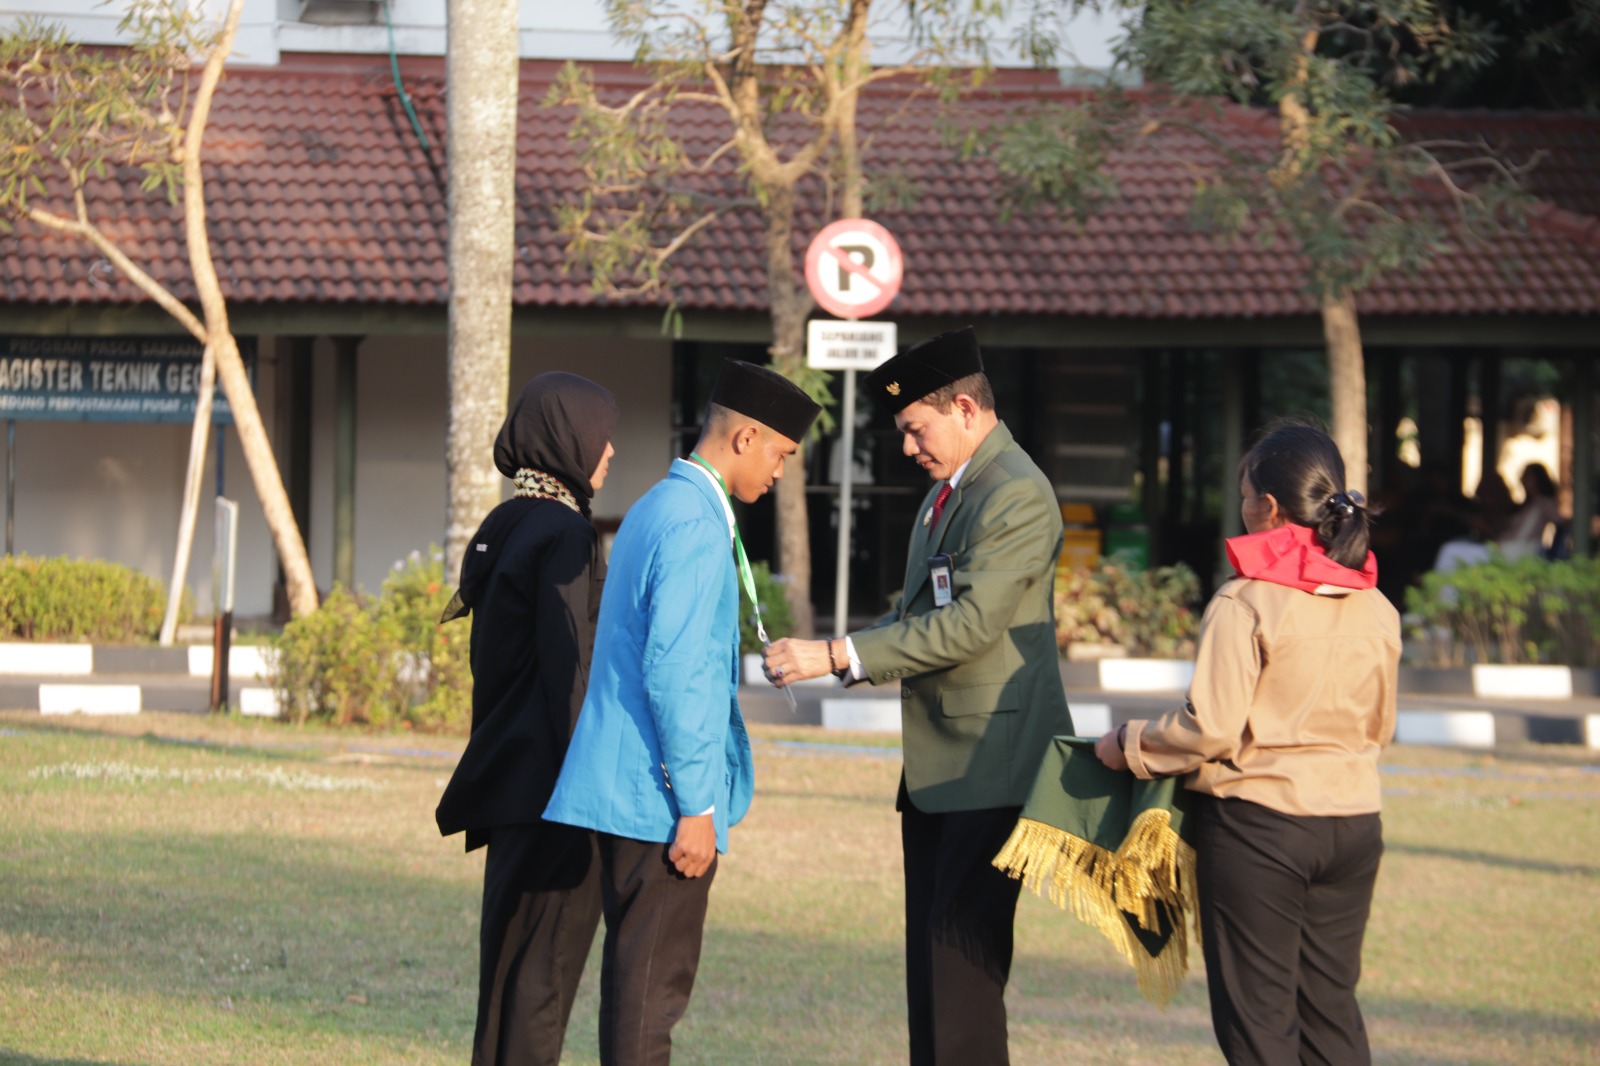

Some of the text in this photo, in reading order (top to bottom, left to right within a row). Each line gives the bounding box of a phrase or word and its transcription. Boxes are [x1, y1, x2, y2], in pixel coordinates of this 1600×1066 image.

[838, 244, 875, 291] P
[90, 360, 162, 393] TEKNIK
[0, 395, 46, 411] EDUNG
